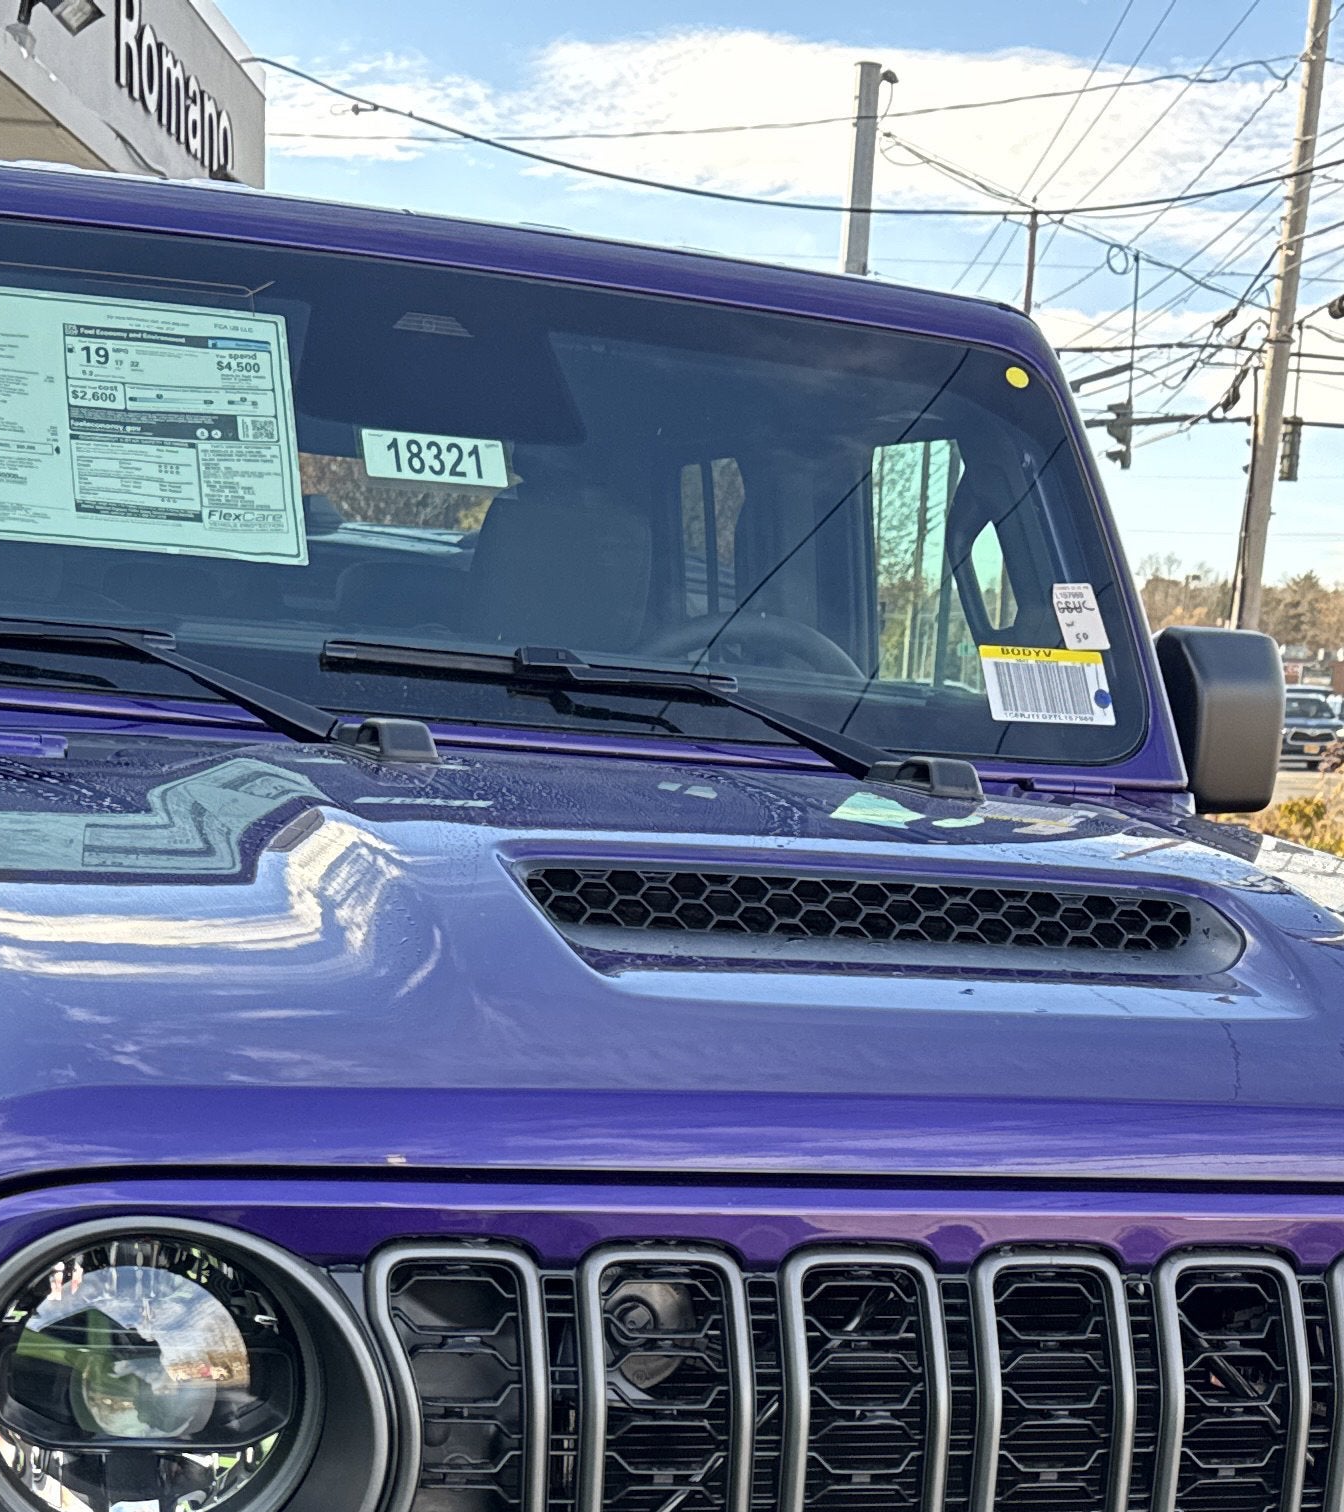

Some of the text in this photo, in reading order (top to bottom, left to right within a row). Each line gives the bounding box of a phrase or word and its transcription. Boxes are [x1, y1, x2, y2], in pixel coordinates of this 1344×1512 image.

[115, 0, 234, 174] Romano
[80, 327, 94, 336] Fuel
[96, 329, 127, 341] Economy
[81, 345, 110, 365] 19
[228, 353, 257, 362] spend
[217, 361, 260, 373] $4,500
[71, 390, 116, 402] $2,600
[387, 437, 484, 479] 18321
[208, 510, 283, 523] FlexCare
[1001, 647, 1052, 658] BODYV
